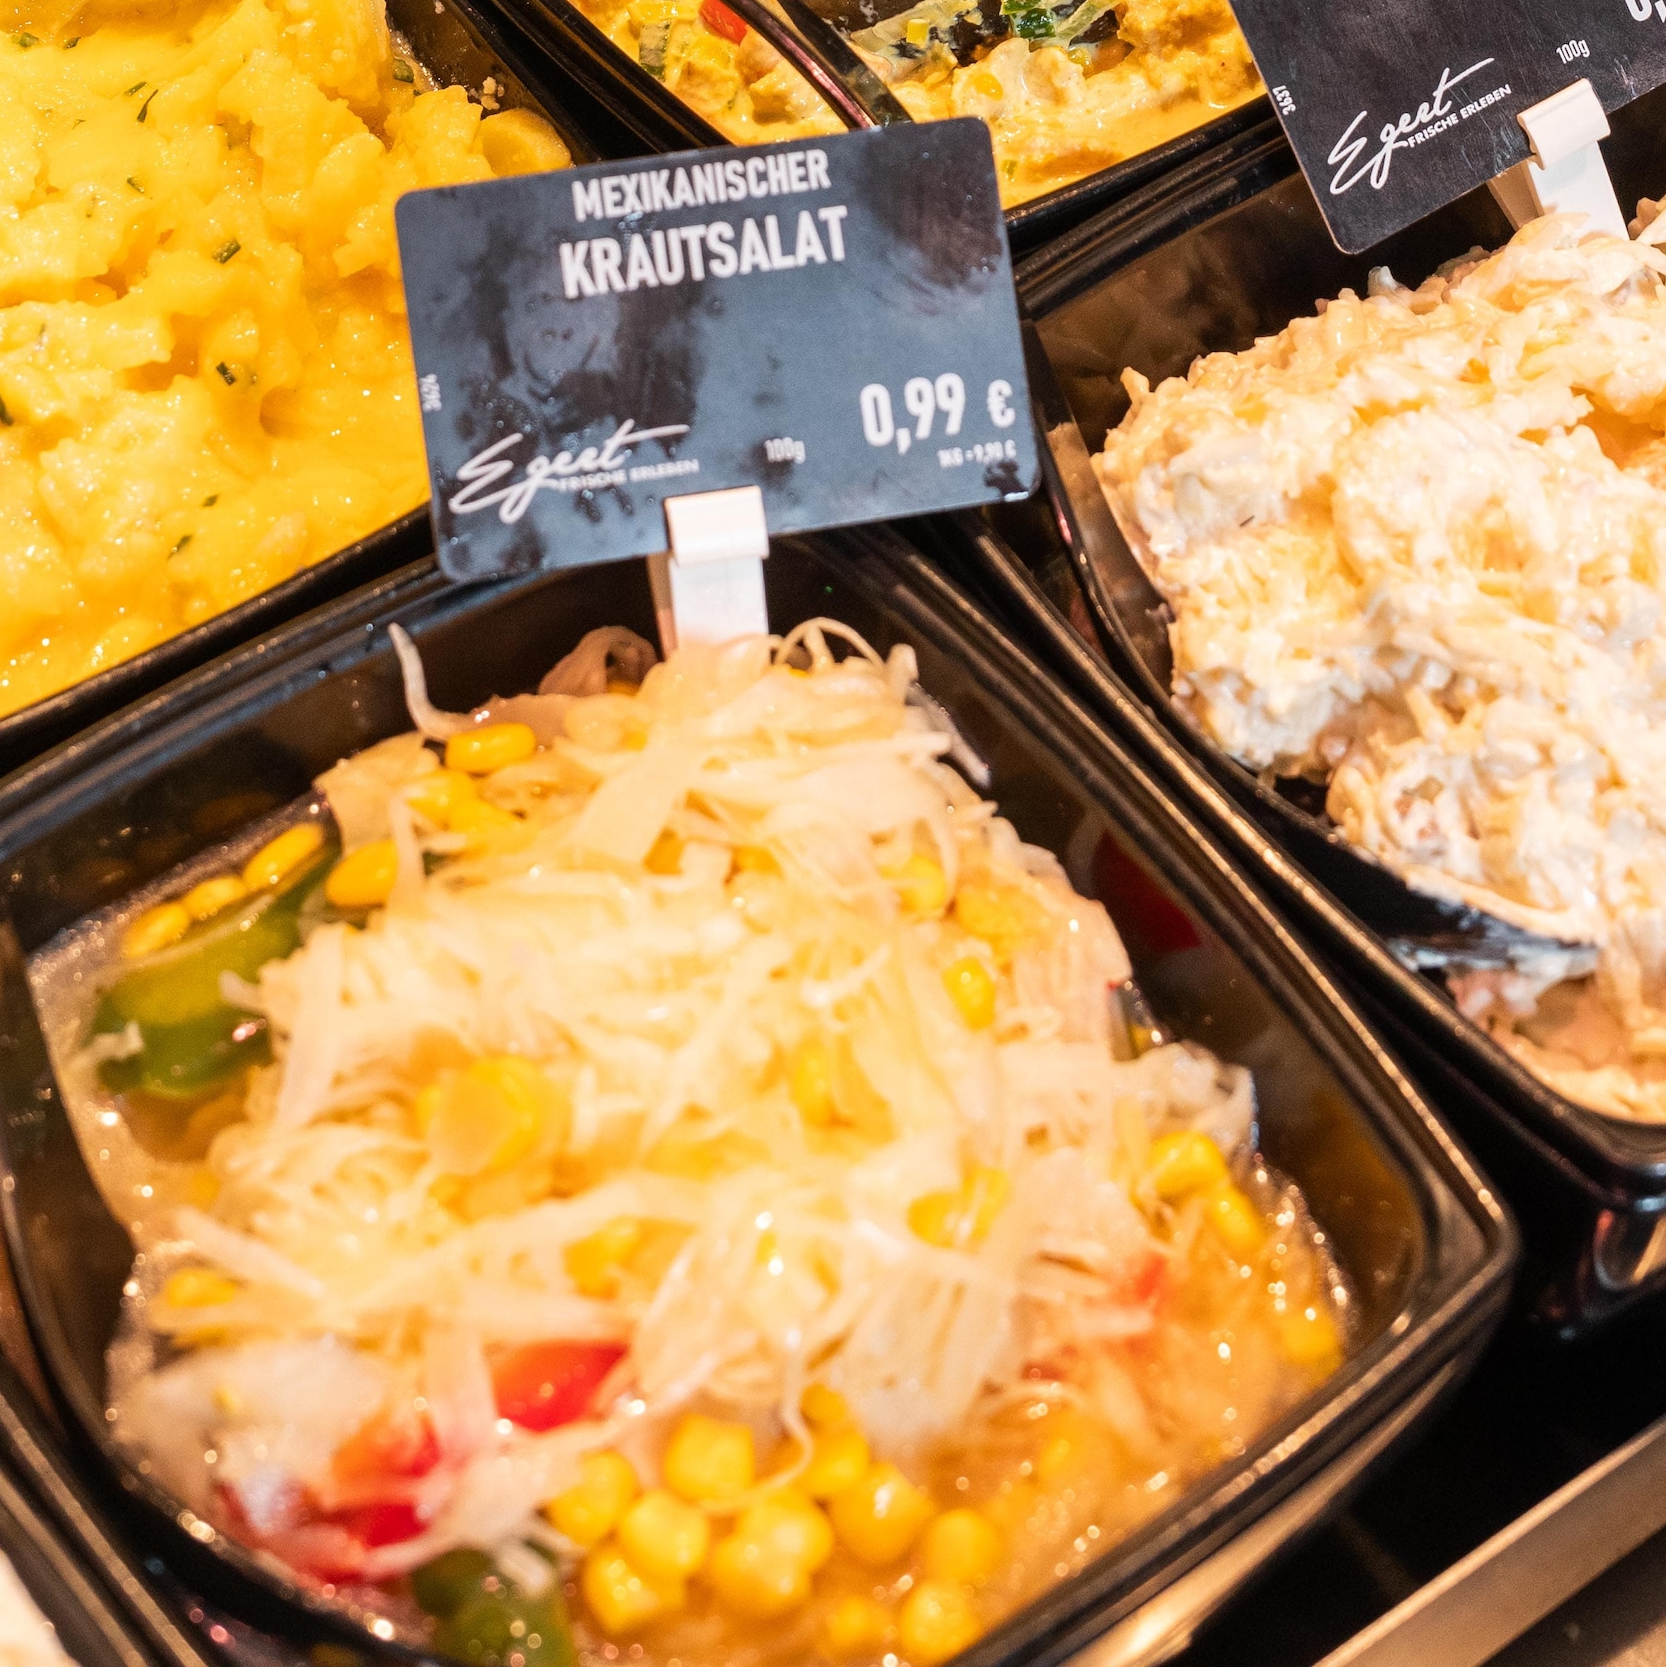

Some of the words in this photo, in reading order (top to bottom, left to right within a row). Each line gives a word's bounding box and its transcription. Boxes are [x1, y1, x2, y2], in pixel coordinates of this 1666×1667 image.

[1555, 36, 1591, 67] 100g
[1272, 85, 1296, 116] 3637
[1406, 112, 1460, 149] FRISCHE
[1459, 83, 1512, 120] ERLEBEN
[572, 149, 831, 222] MEXIKANISCHER
[559, 205, 848, 298] KRAUTSALAT
[859, 373, 966, 455] 0,99
[986, 379, 1015, 428] €
[763, 434, 807, 467] 100g
